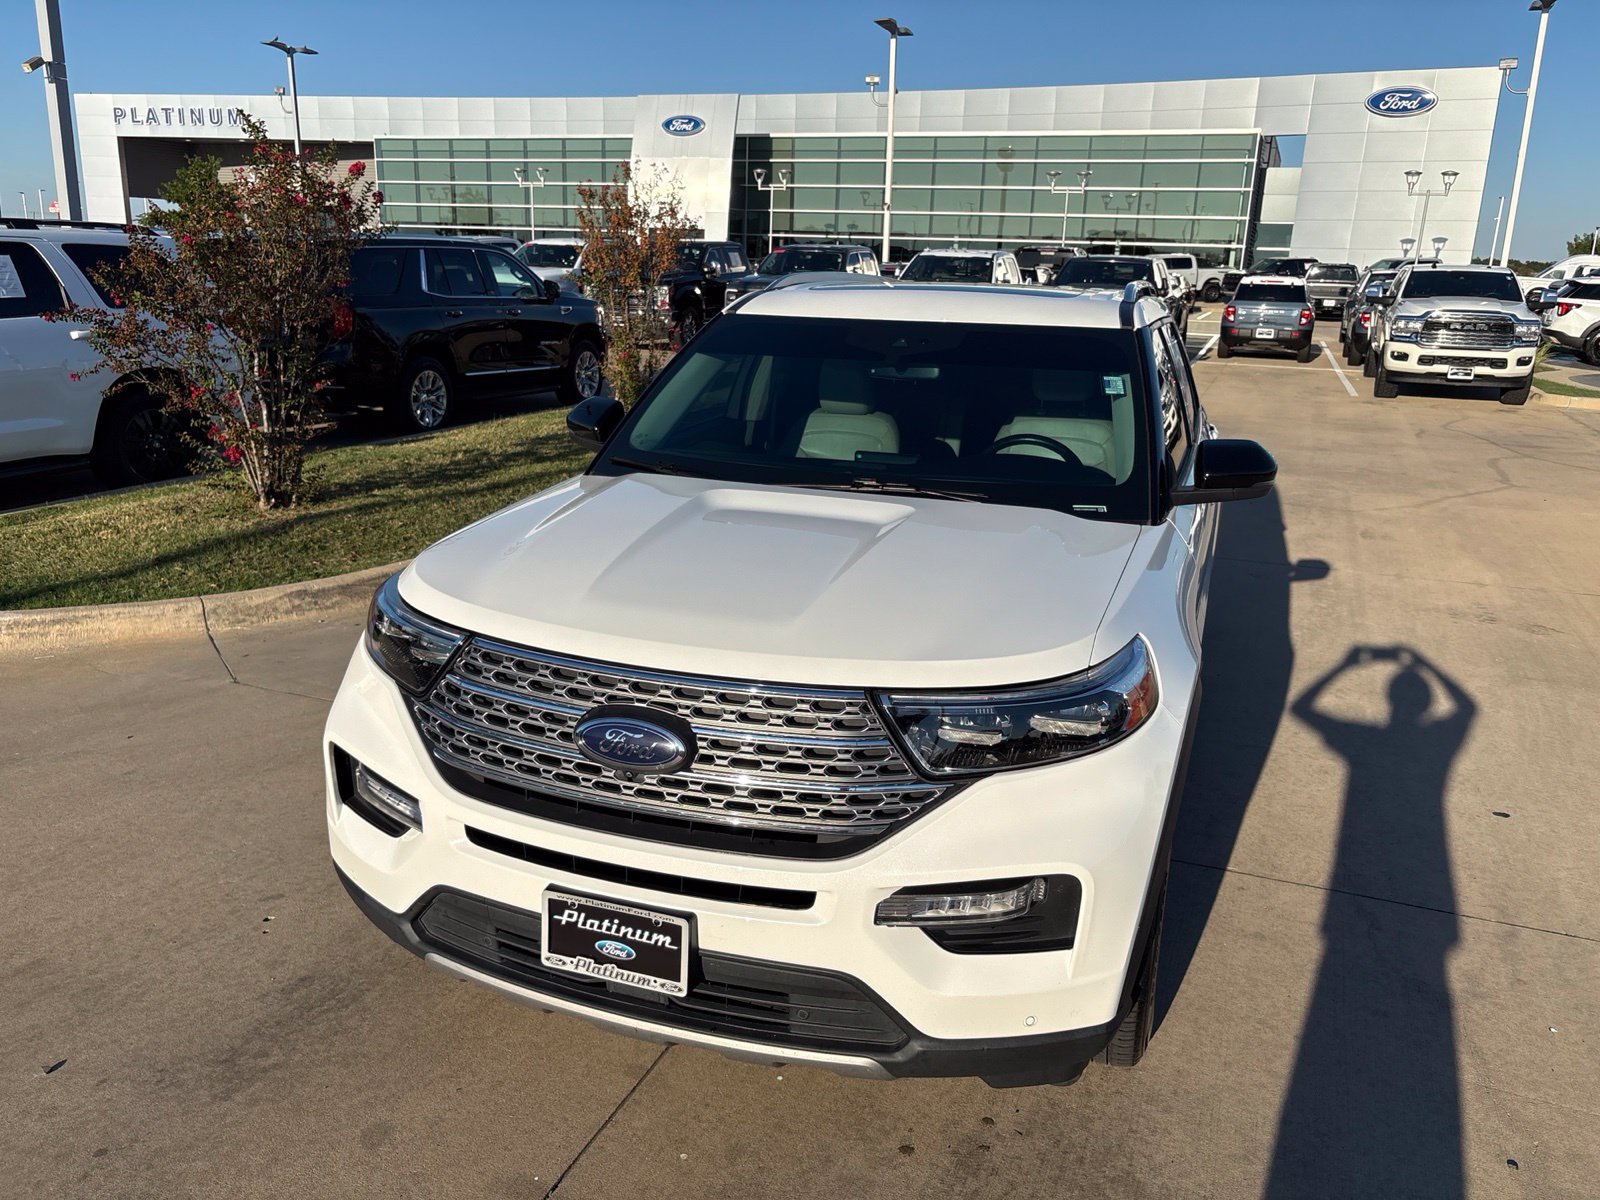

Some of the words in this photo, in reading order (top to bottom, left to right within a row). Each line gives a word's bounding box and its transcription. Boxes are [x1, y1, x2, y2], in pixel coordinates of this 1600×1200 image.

[113, 106, 243, 128] PLATINUM
[1449, 322, 1489, 331] RAM
[599, 728, 656, 760] Ford
[553, 909, 679, 950] Platinum
[574, 957, 652, 988] Platinum
